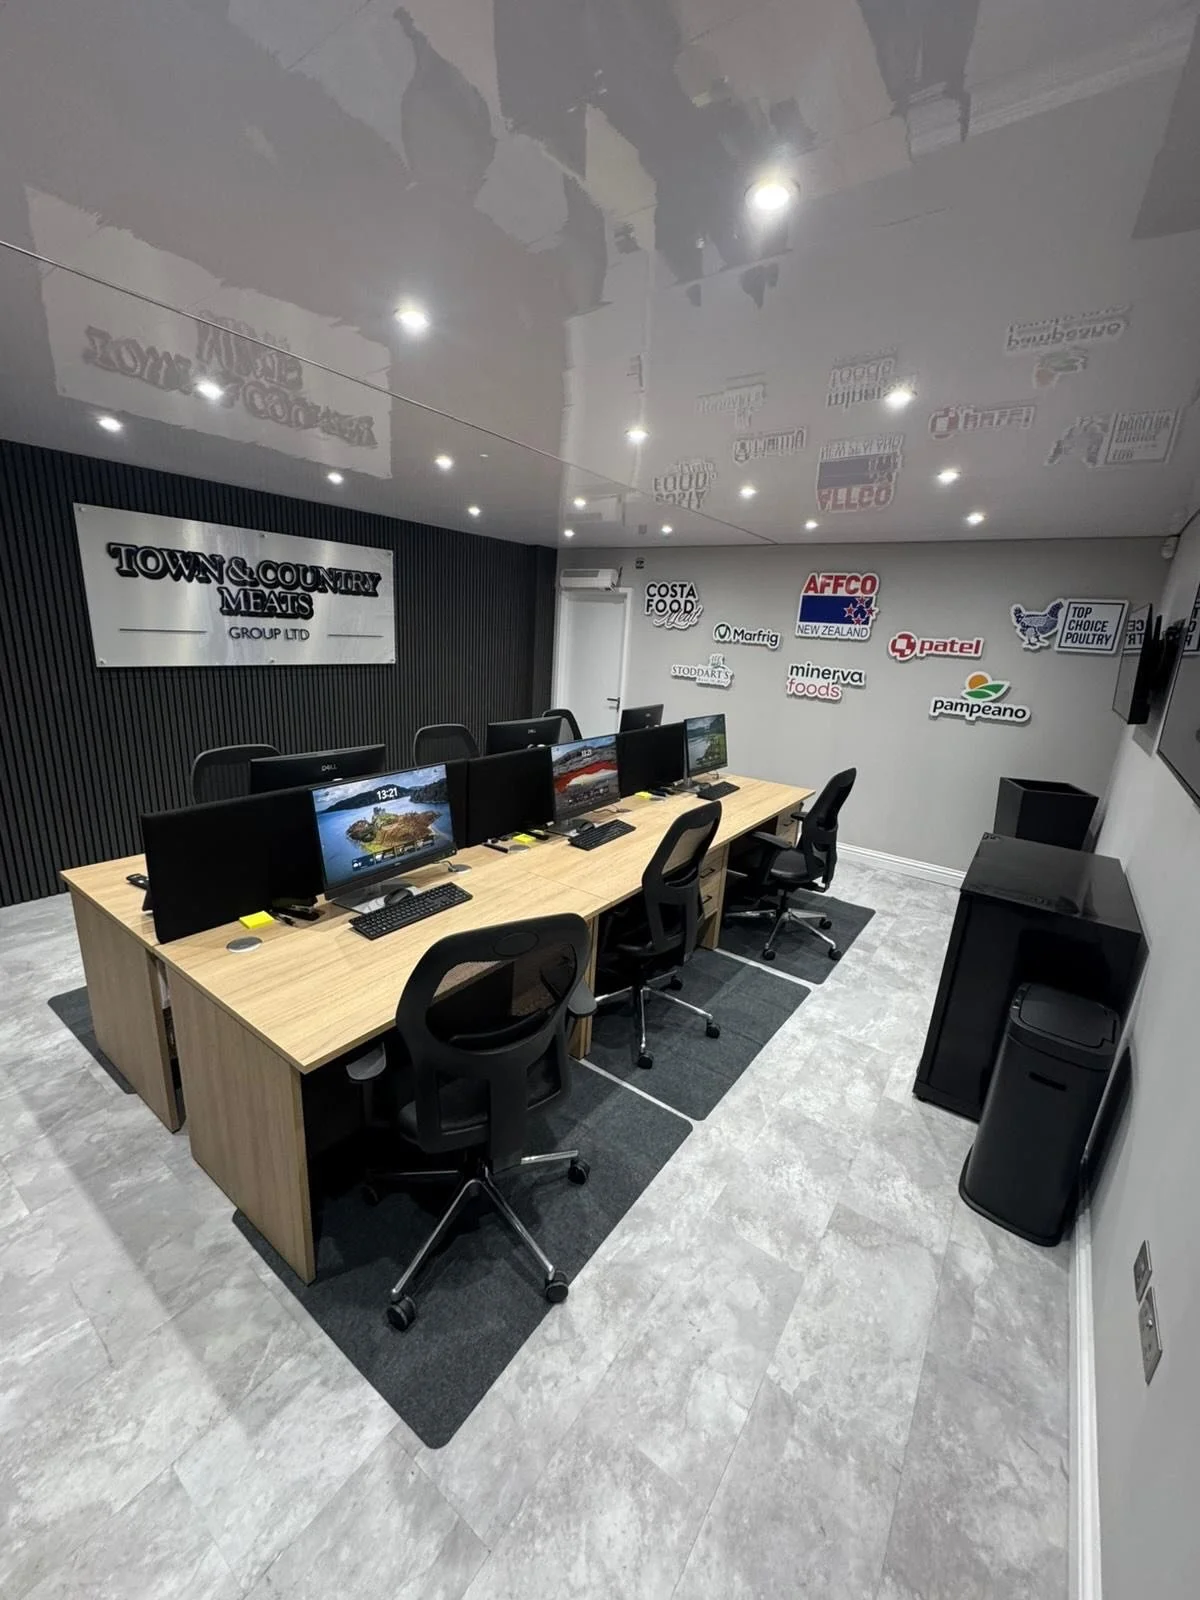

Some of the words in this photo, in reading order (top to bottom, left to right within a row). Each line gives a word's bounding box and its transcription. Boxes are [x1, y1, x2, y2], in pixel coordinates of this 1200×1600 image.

[107, 543, 224, 584] TOWN
[225, 557, 258, 583] &
[256, 560, 382, 597] COUNTRY
[646, 583, 697, 598] COSTA
[803, 574, 878, 595] AFFCO
[219, 586, 315, 620] MEATS
[646, 598, 695, 614] FOOD
[1072, 606, 1093, 619] TOP
[228, 626, 281, 641] GROUP
[284, 628, 310, 642] LTD
[796, 624, 820, 636] NEW
[821, 625, 869, 639] ZEALAND
[1067, 619, 1109, 633] CHOICE
[732, 628, 779, 647] Marfrig
[918, 637, 981, 655] patel
[1064, 632, 1112, 646] POULTRY
[789, 663, 863, 684] minerva
[787, 678, 841, 699] foods
[932, 698, 1027, 720] pampeano
[376, 787, 398, 800] 13:21
